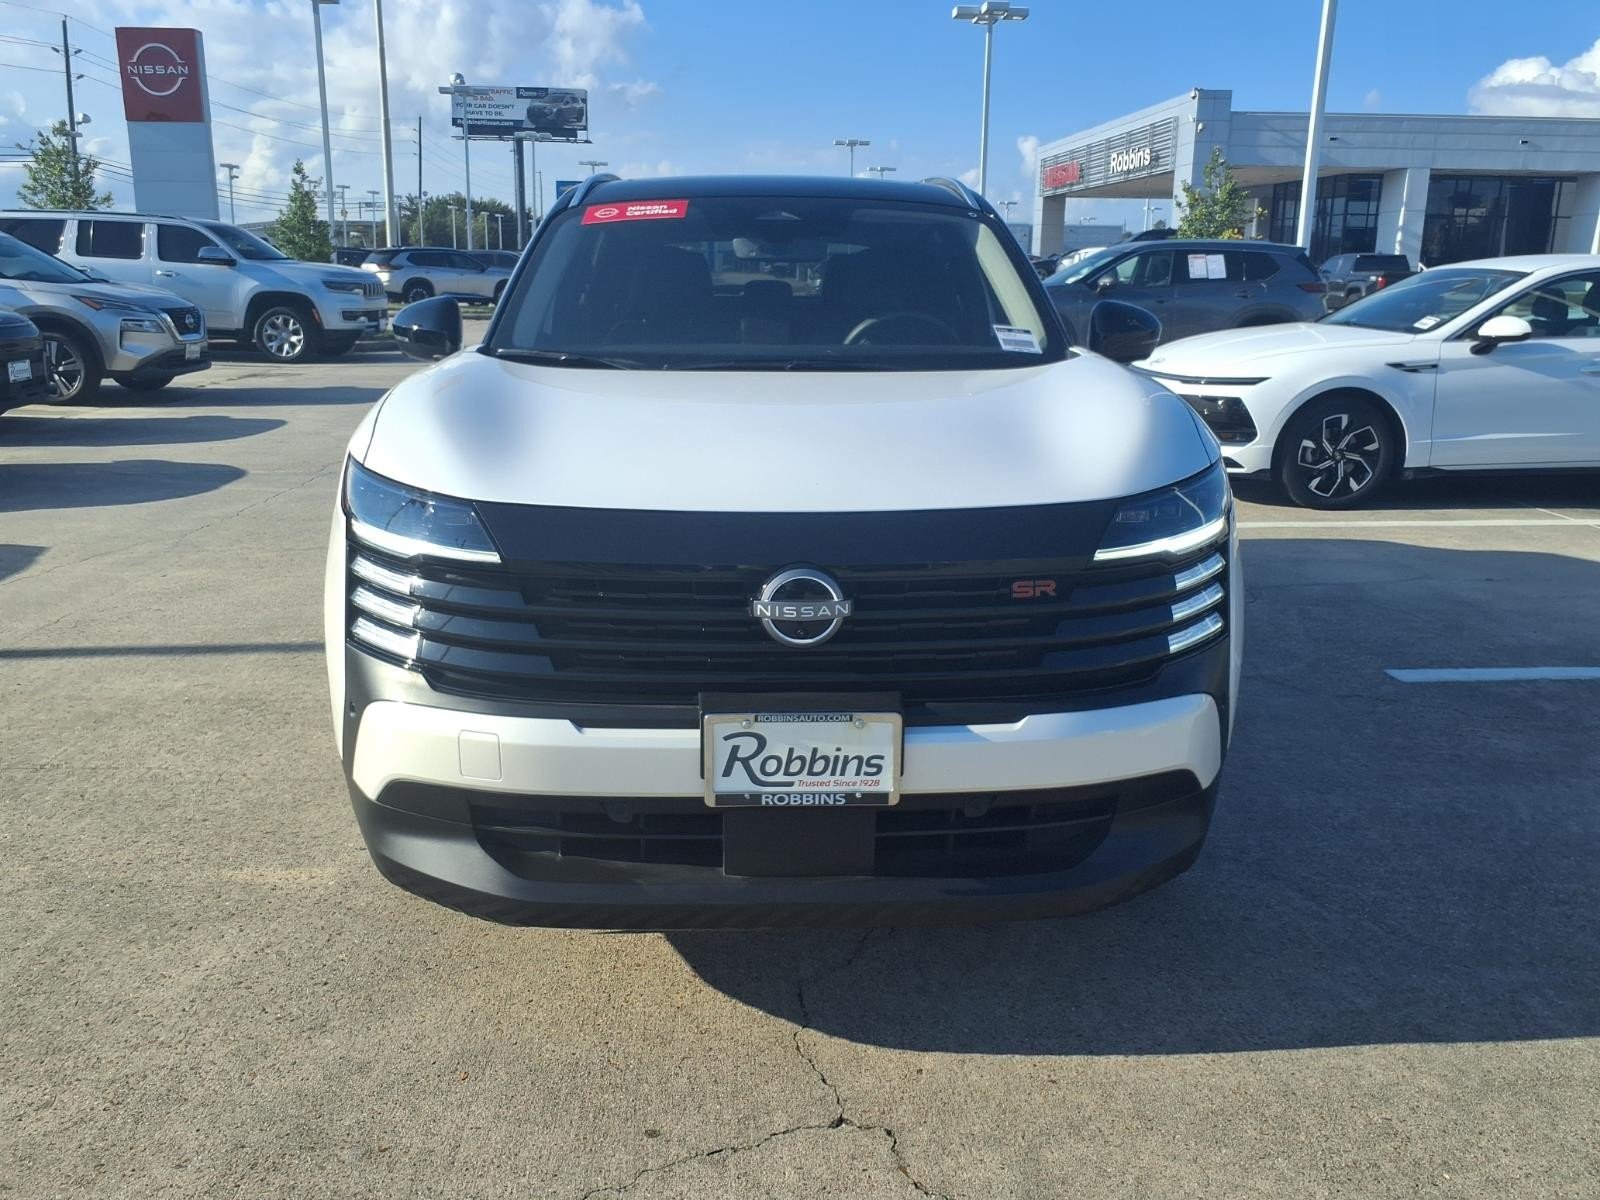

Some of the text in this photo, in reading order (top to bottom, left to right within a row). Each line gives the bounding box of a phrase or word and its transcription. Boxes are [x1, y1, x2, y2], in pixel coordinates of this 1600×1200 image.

[128, 65, 188, 75] NISSAN
[1110, 147, 1151, 174] Robbins
[626, 208, 678, 216] Certified
[1012, 580, 1057, 598] SR
[757, 603, 849, 617] NISSAN
[757, 714, 851, 723] ROBBINSAUTO.COM
[722, 731, 885, 787] Robbins
[798, 779, 880, 787] Trusted Since 1928
[761, 793, 846, 805] ROBBINS
